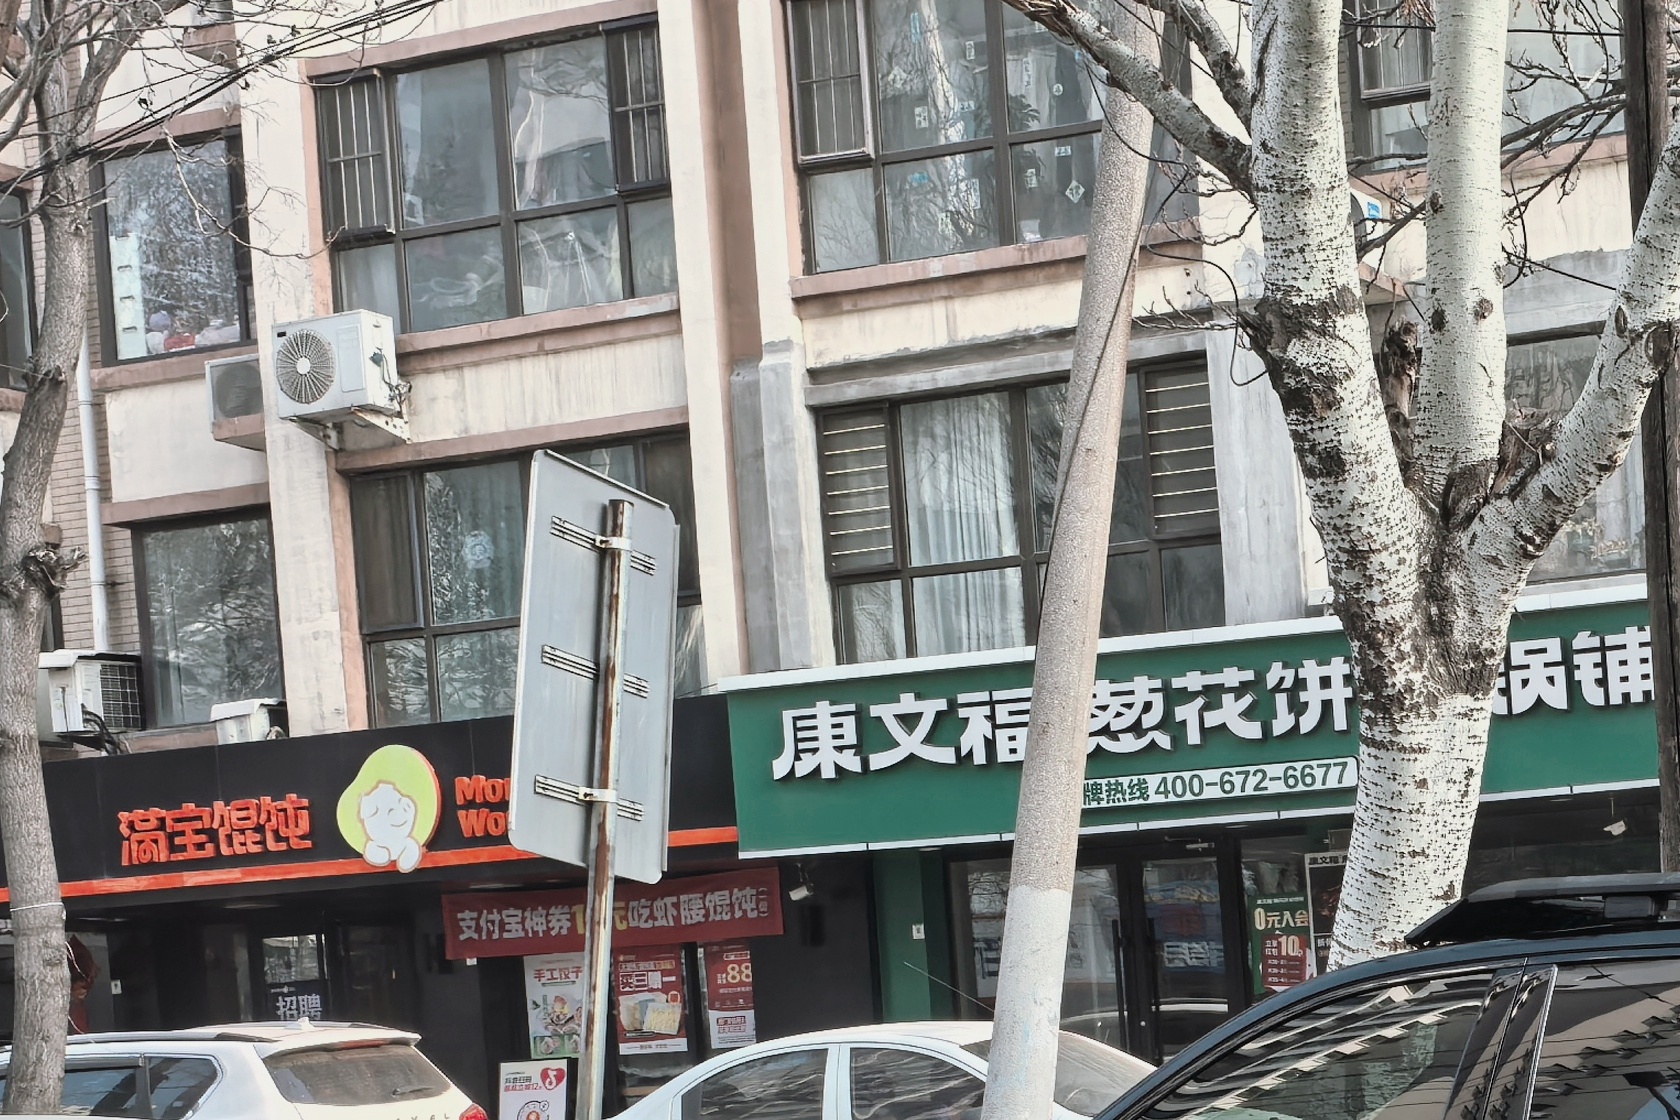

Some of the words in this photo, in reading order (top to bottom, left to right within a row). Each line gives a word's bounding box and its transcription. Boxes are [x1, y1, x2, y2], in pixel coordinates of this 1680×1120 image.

[1154, 761, 1349, 800] 400-672-6677
[457, 808, 510, 838] Wo
[276, 993, 322, 1020] 招聘
